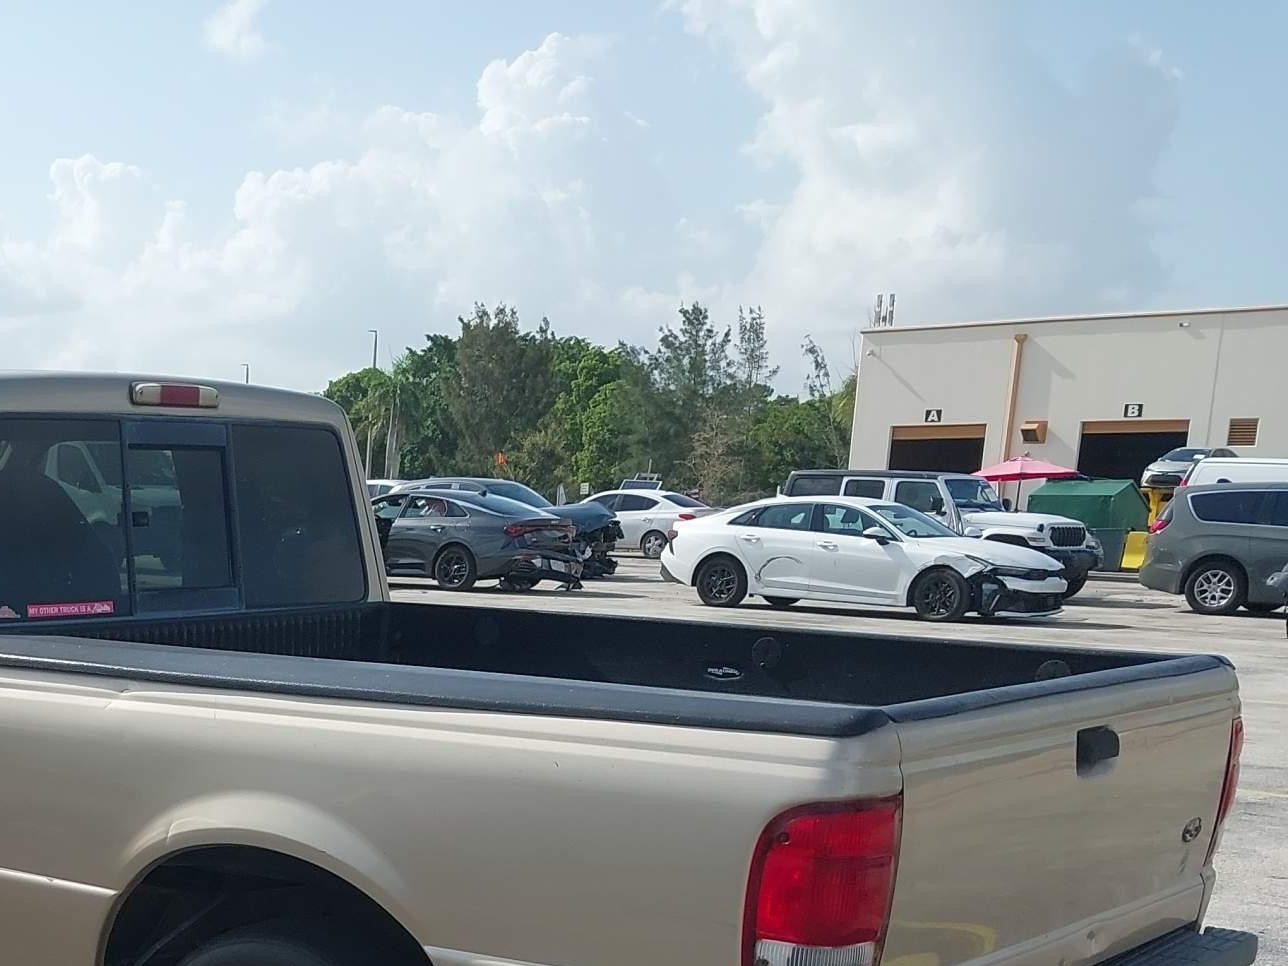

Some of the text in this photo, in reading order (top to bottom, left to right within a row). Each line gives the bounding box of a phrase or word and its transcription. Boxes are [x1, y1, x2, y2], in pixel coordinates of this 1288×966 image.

[927, 410, 939, 422] A
[1128, 404, 1139, 417] B
[28, 607, 39, 616] MY
[39, 606, 59, 615] OTHER
[59, 606, 80, 614] TRUCK
[80, 605, 86, 613] IS
